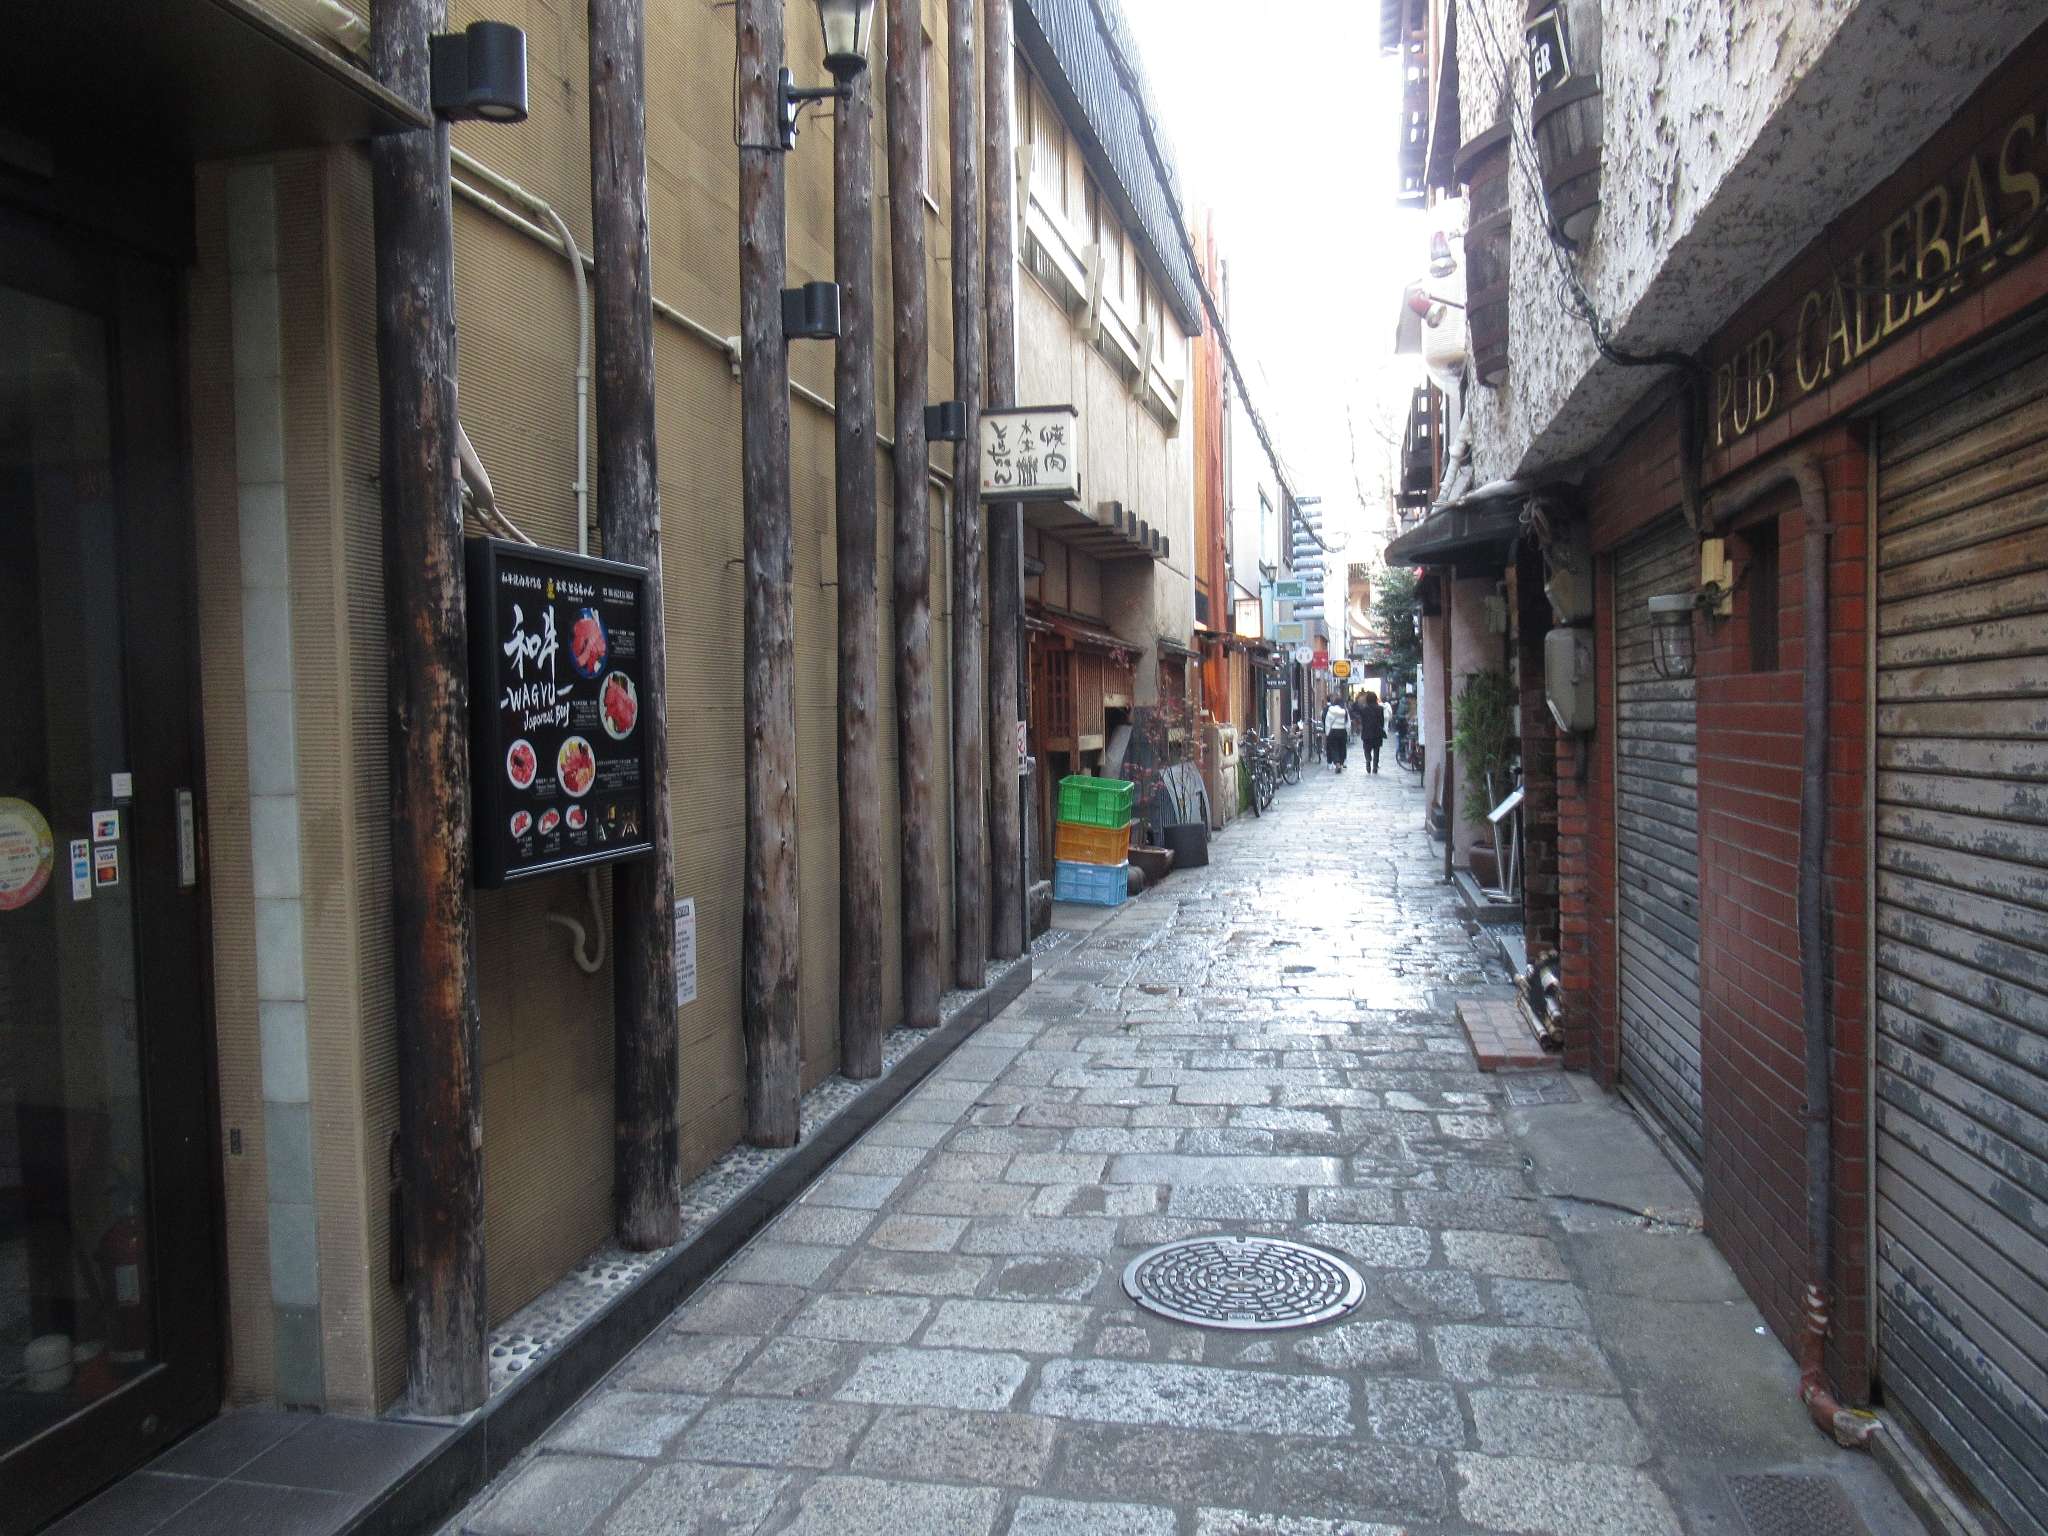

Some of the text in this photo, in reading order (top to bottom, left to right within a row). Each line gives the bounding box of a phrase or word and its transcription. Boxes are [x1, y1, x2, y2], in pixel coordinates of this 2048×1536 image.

[1715, 329, 1775, 446] PUB
[503, 603, 560, 681] 和牛
[99, 853, 114, 861] VISA
